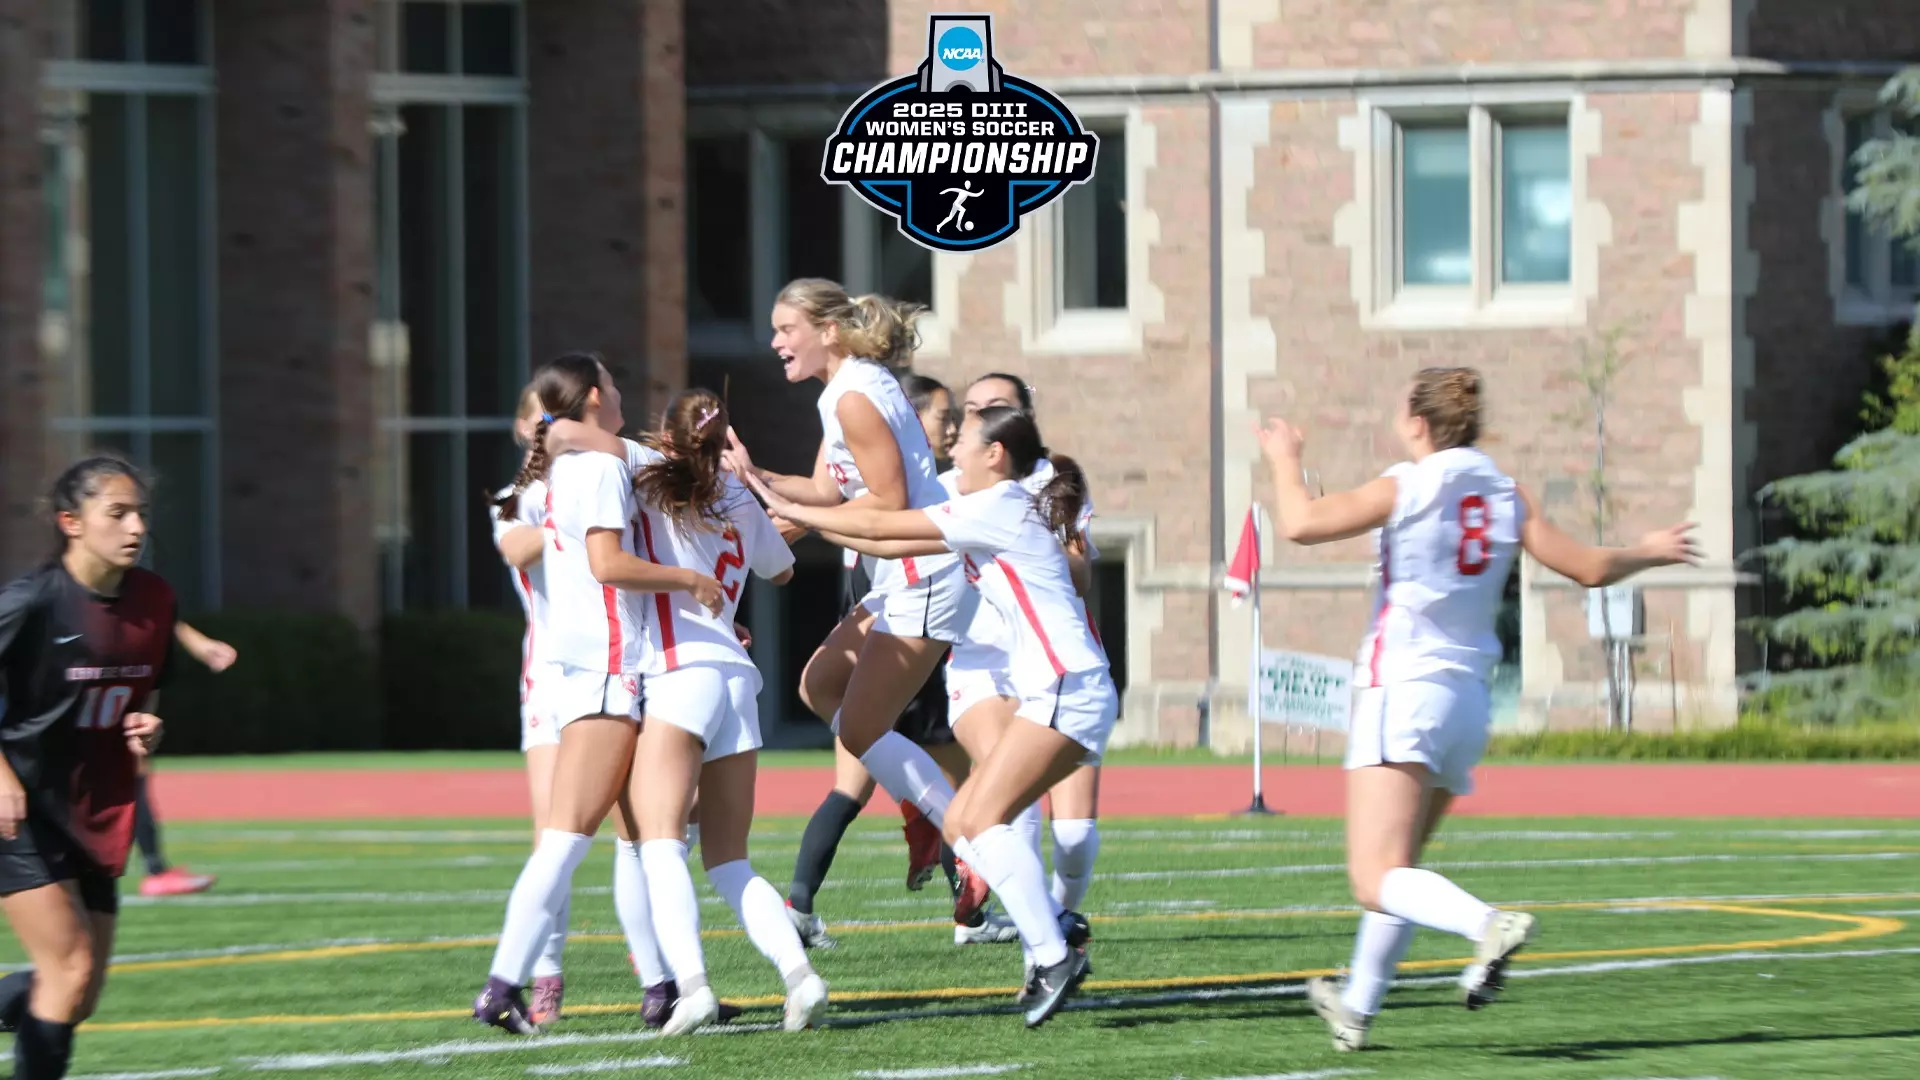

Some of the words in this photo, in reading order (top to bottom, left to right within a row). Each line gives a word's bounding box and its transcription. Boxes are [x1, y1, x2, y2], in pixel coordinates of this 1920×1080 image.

[715, 528, 745, 602] 2
[1458, 494, 1491, 576] 8
[78, 686, 133, 728] 10
